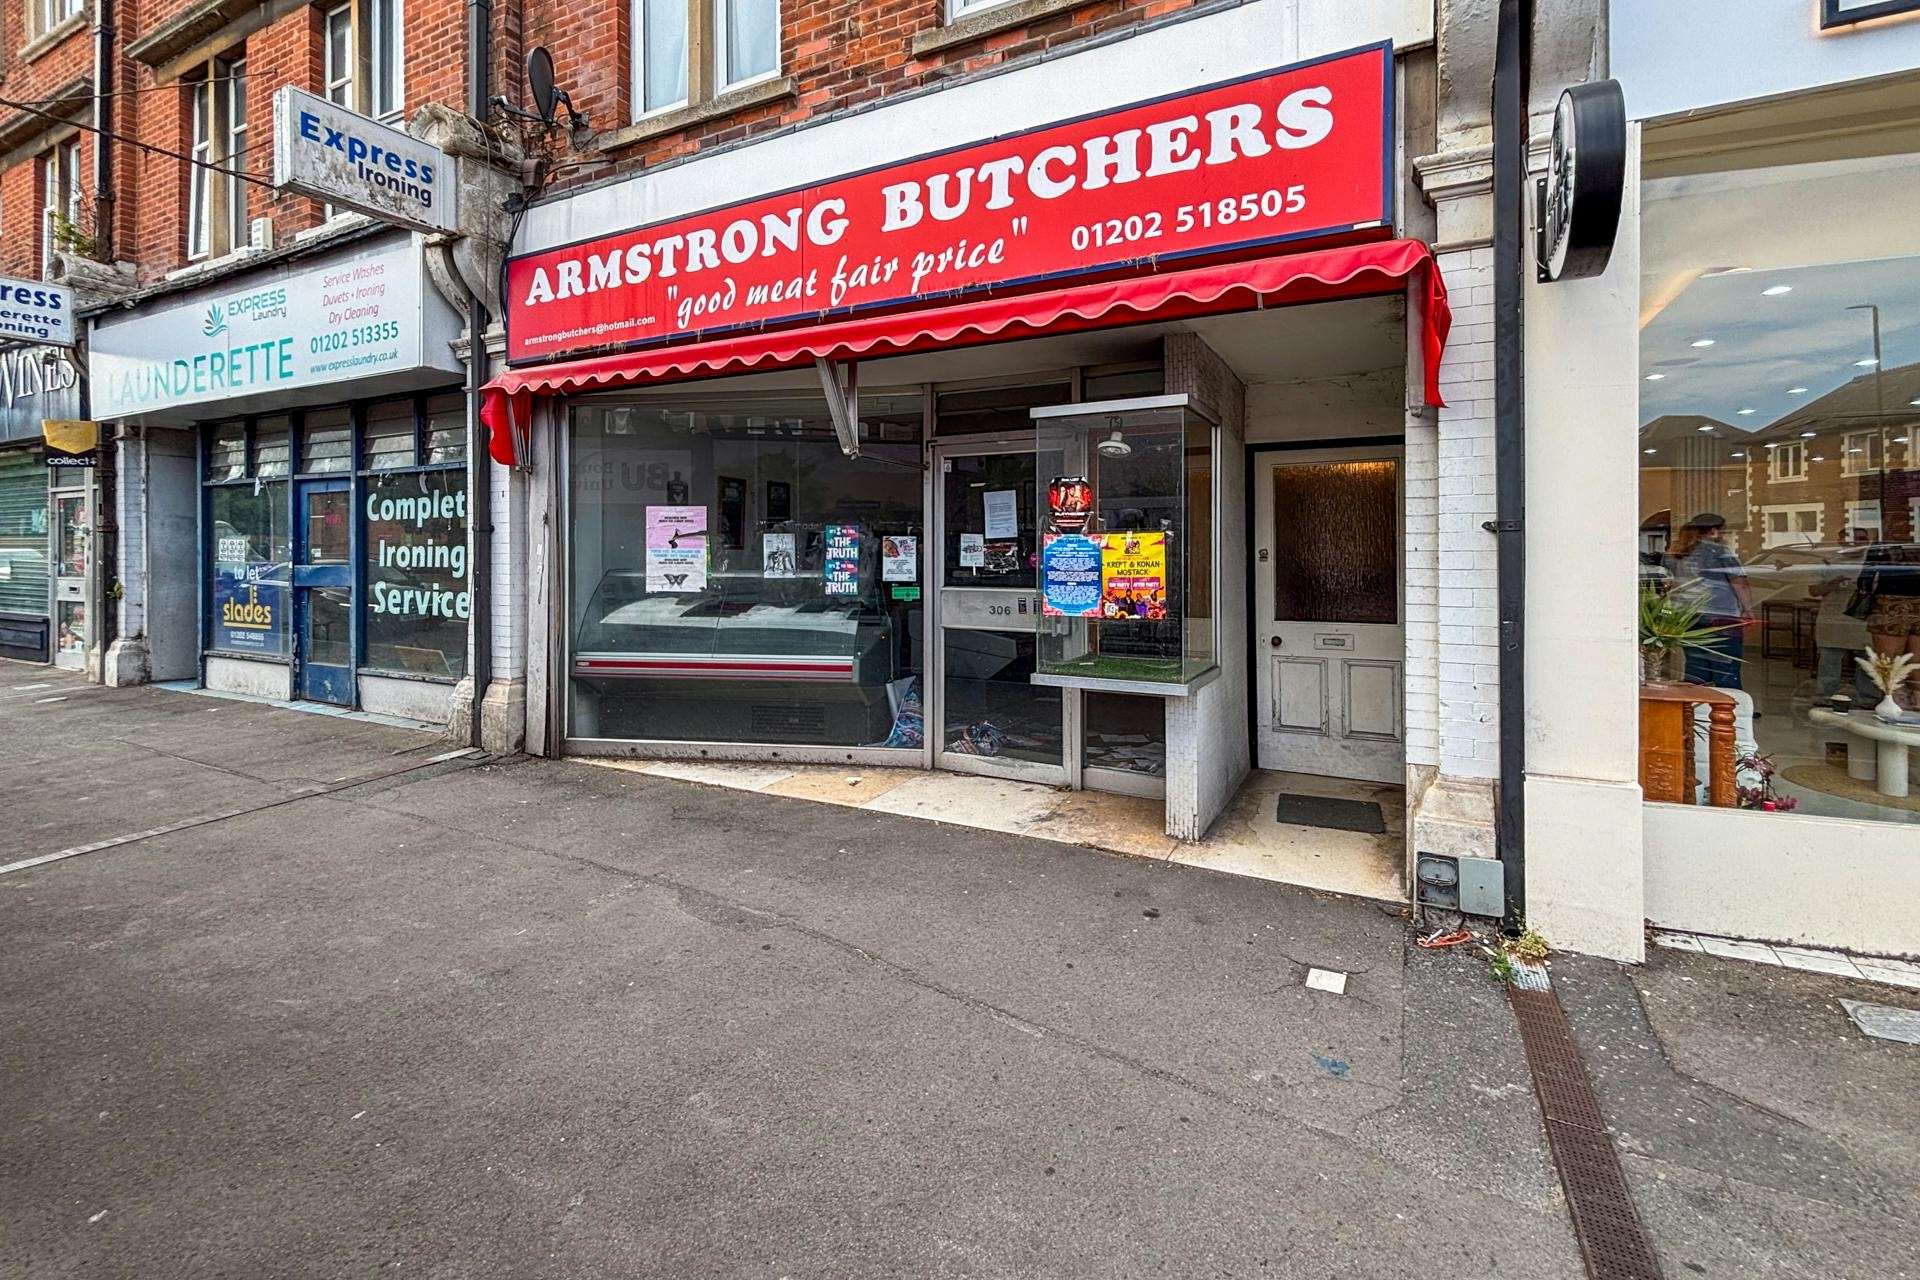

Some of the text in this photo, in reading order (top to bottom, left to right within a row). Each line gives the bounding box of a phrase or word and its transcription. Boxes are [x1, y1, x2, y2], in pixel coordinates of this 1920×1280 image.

[300, 111, 433, 185] Express
[358, 162, 432, 208] Ironing
[525, 85, 1334, 306] ARMSTRONG BUTCHERS
[1071, 184, 1306, 251] 01202 518505
[323, 263, 384, 288] Service Washes
[228, 288, 286, 317] EXPRESS
[323, 283, 385, 307] Duvets Ironing
[667, 278, 737, 329] "good
[746, 274, 817, 307] meat
[830, 255, 899, 306] fair
[252, 305, 287, 324] Laundry
[329, 304, 379, 325] Dry Cleaning
[310, 321, 399, 353] 01202 513355
[524, 315, 656, 346] armstrongbutchers@hotmail.com
[109, 337, 294, 407] LAUNDERETTE
[827, 547, 858, 559] TRUTH
[834, 536, 851, 547] THE
[234, 565, 260, 581] to let
[379, 538, 465, 579] Ironing
[827, 582, 858, 593] TRUTH
[833, 571, 851, 581] THE
[223, 585, 272, 623] slades
[374, 581, 469, 619] Service
[989, 605, 1011, 615] 306
